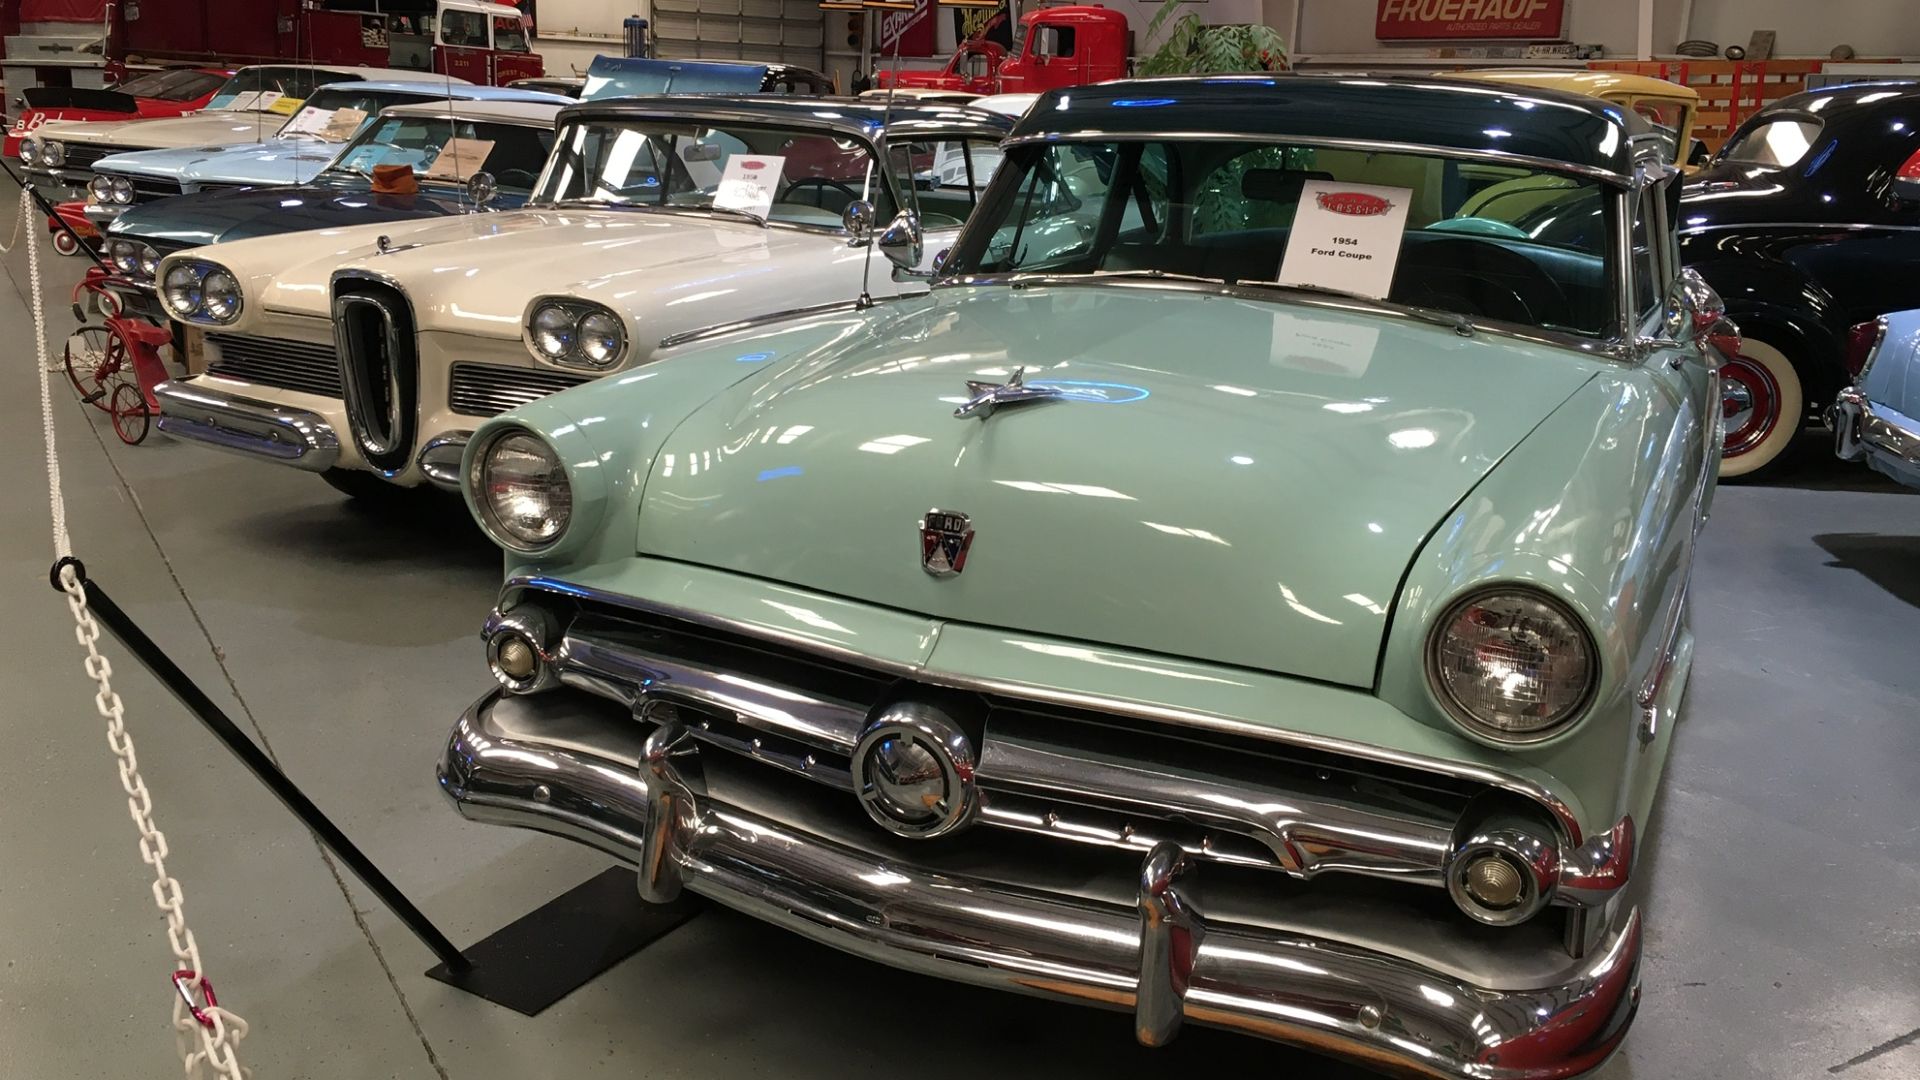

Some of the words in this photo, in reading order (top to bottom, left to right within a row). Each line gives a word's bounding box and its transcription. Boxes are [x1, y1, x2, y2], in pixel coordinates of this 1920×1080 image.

[1381, 0, 1548, 22] FRUEHAUF
[1512, 21, 1542, 30] DEALER
[1332, 237, 1358, 245] 1954
[1311, 248, 1335, 256] Ford
[1338, 251, 1372, 261] Coupe
